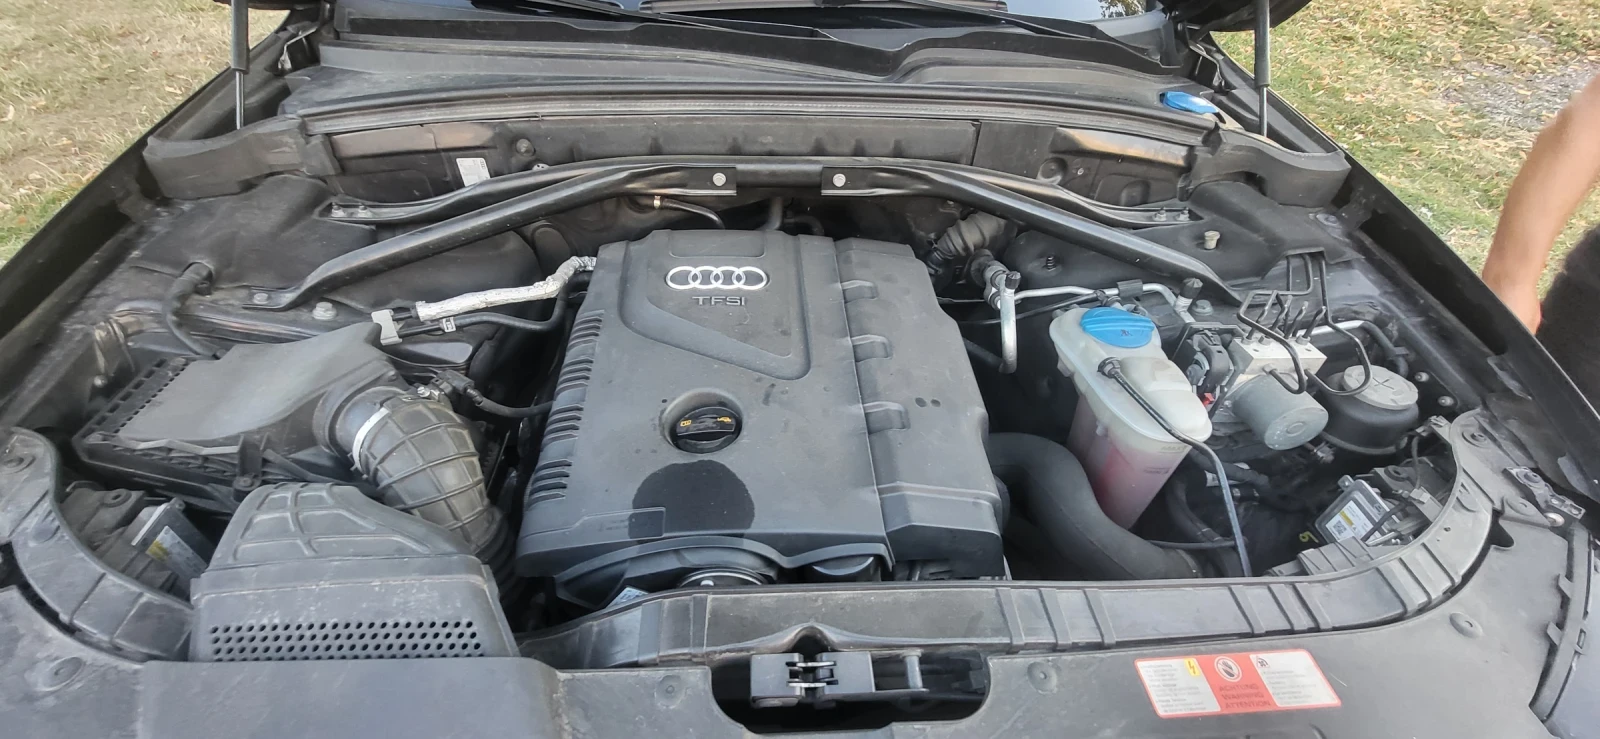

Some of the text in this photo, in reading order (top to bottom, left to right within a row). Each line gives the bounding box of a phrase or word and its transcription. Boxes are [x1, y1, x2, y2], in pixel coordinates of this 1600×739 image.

[692, 296, 746, 306] TFSI
[1219, 683, 1260, 692] ACHTUNG
[1221, 692, 1265, 701] WARNING
[1225, 700, 1272, 709] ATTENTION
